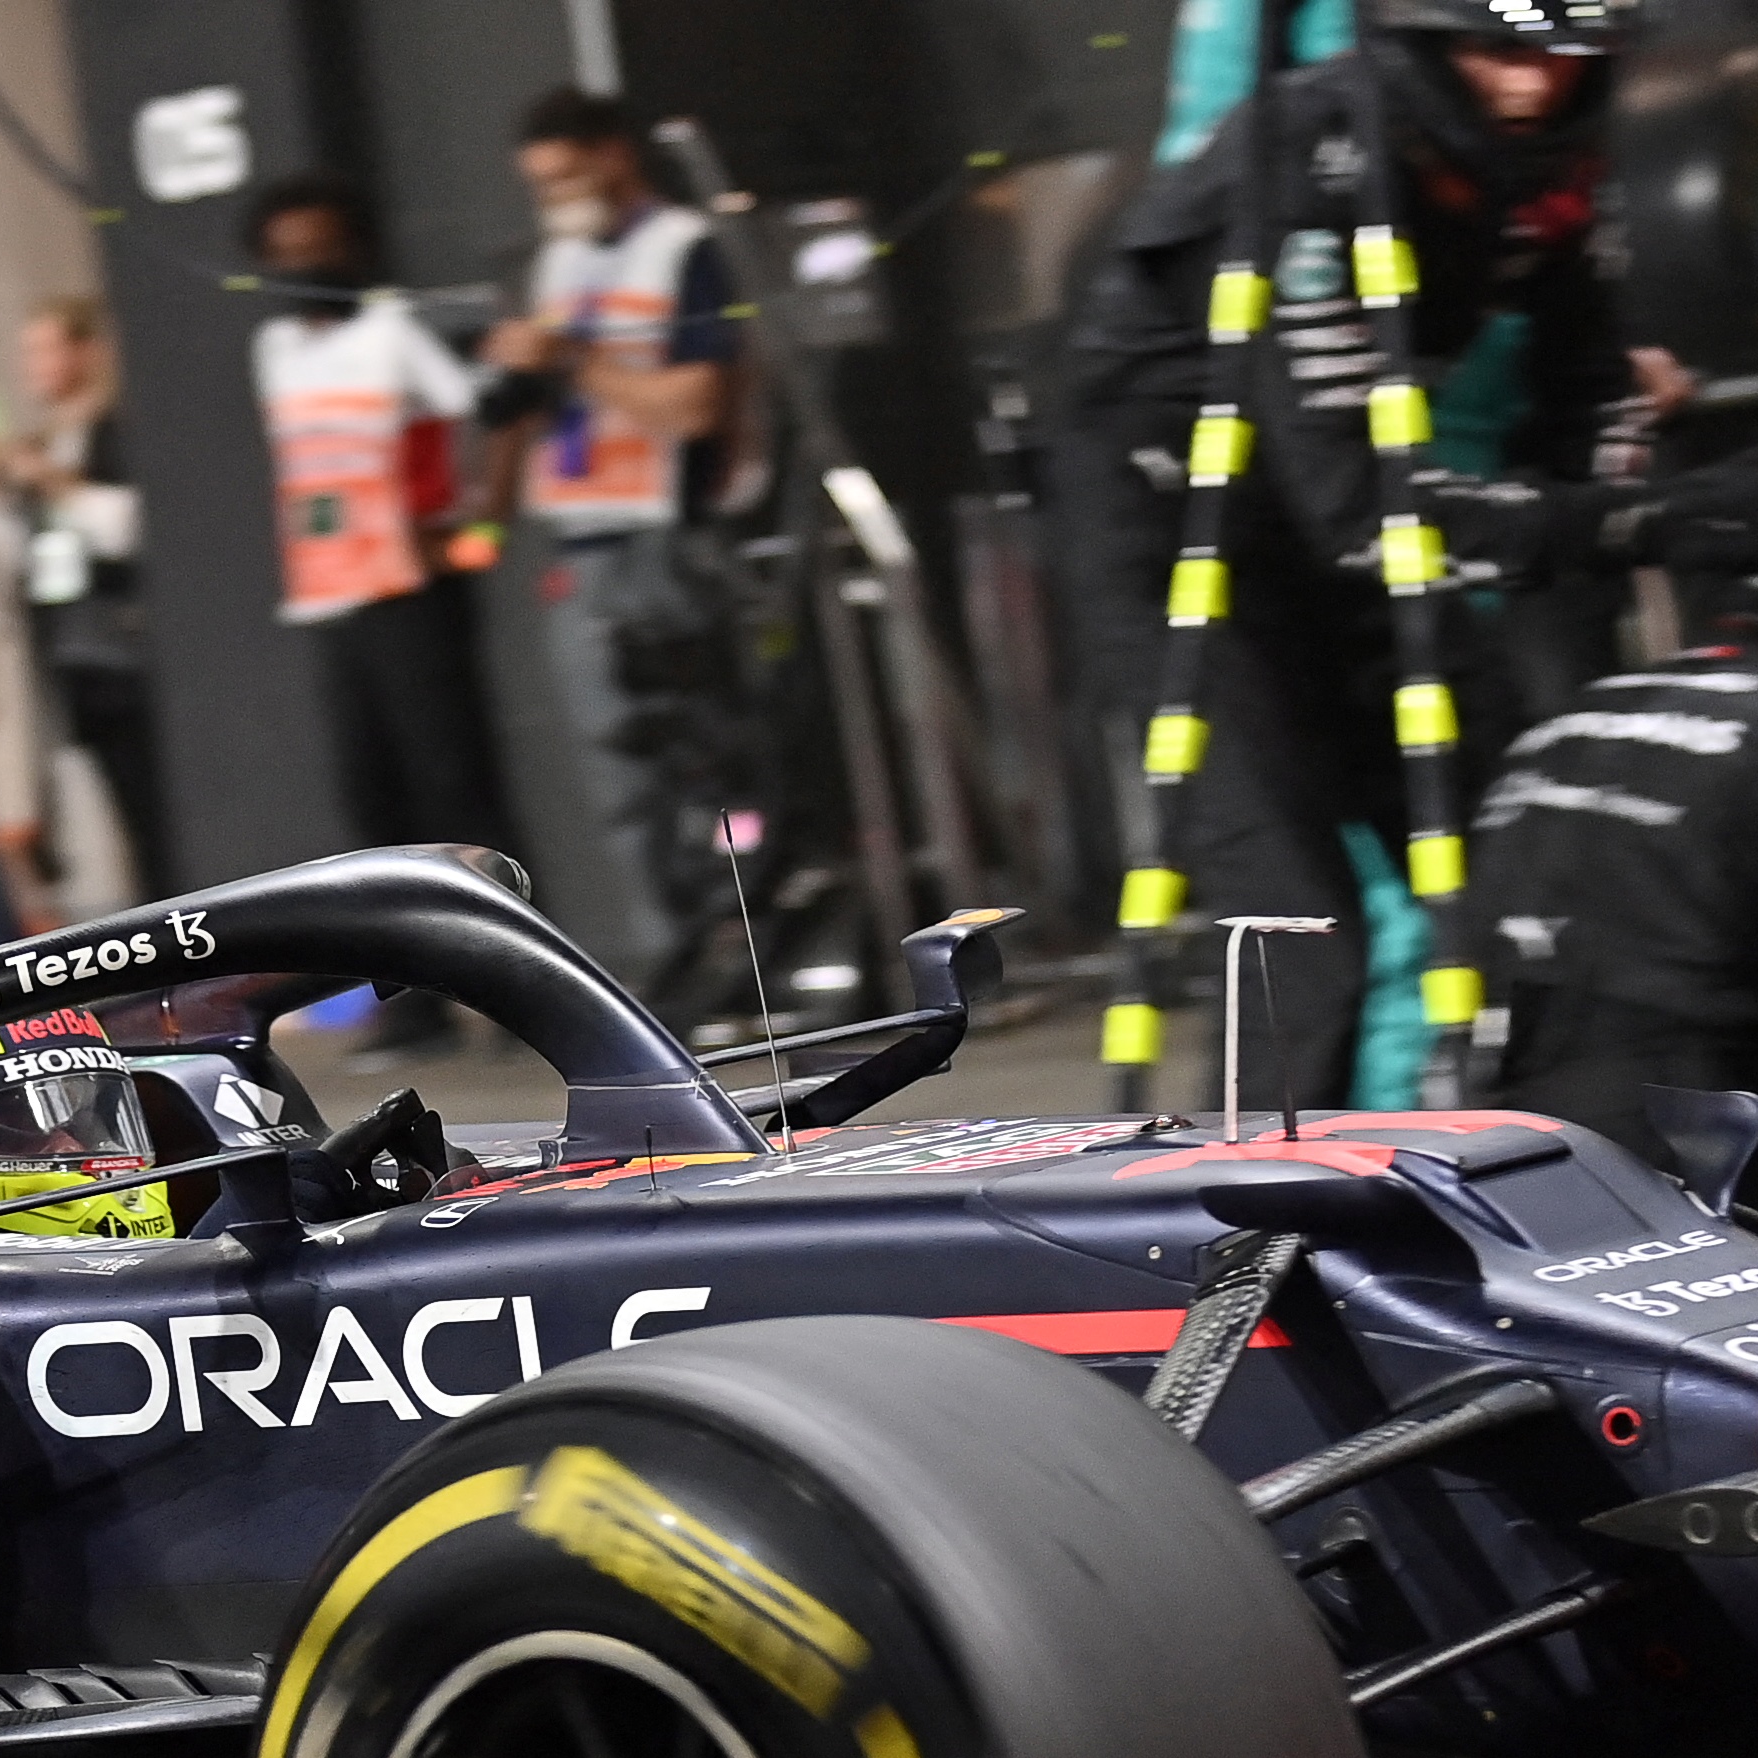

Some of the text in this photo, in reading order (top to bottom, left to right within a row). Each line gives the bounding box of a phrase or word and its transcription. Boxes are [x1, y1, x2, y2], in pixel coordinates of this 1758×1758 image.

[5, 932, 157, 994] Tezos
[236, 1123, 313, 1147] INTER
[1533, 1229, 1728, 1282] ORACLE
